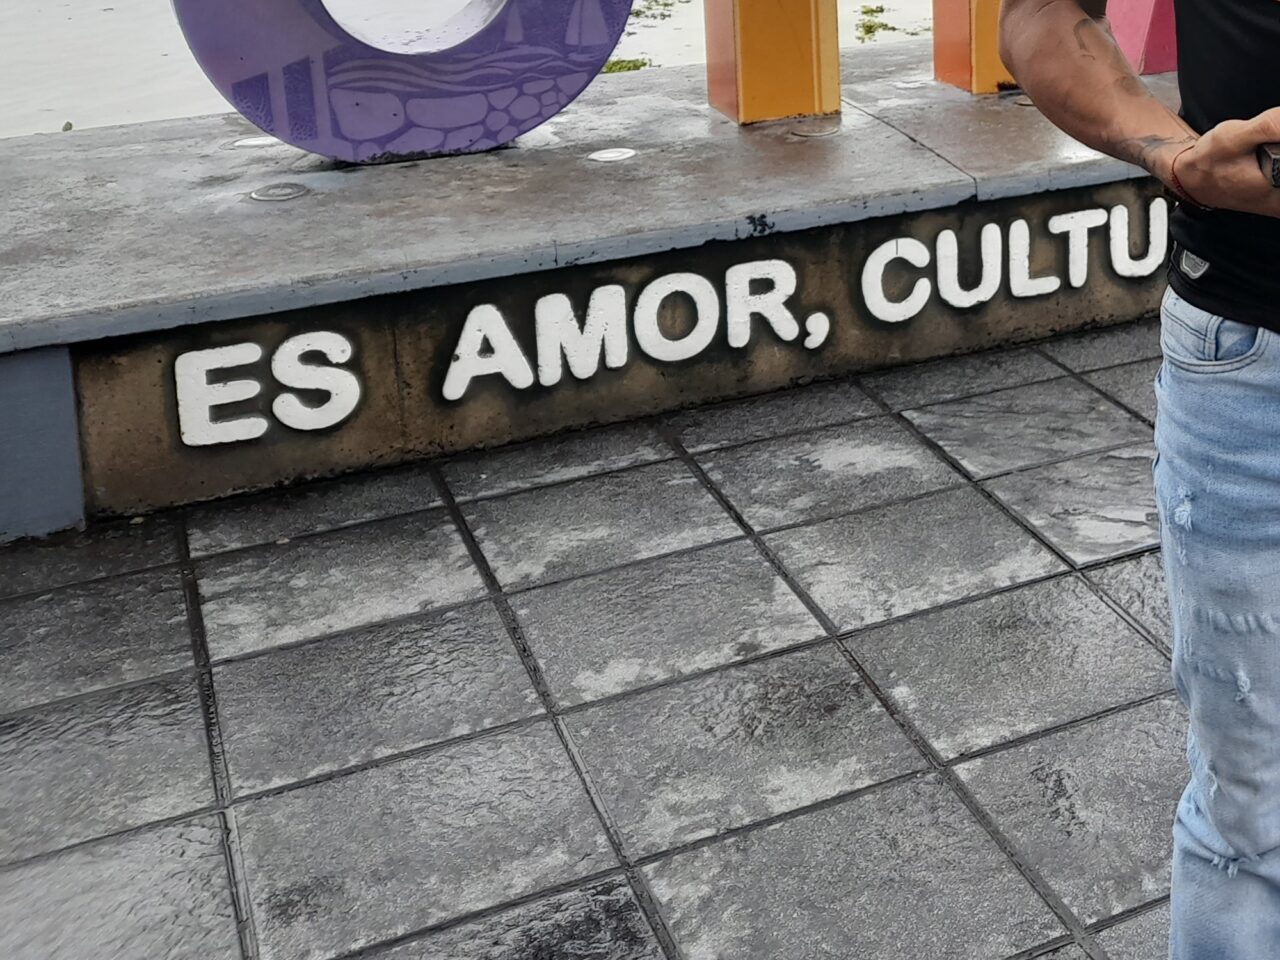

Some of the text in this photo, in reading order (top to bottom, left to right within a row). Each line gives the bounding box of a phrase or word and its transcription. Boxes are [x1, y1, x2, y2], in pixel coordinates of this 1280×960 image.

[175, 331, 361, 446] ES
[443, 259, 830, 400] AMOR,
[861, 196, 1179, 322] CULTU
